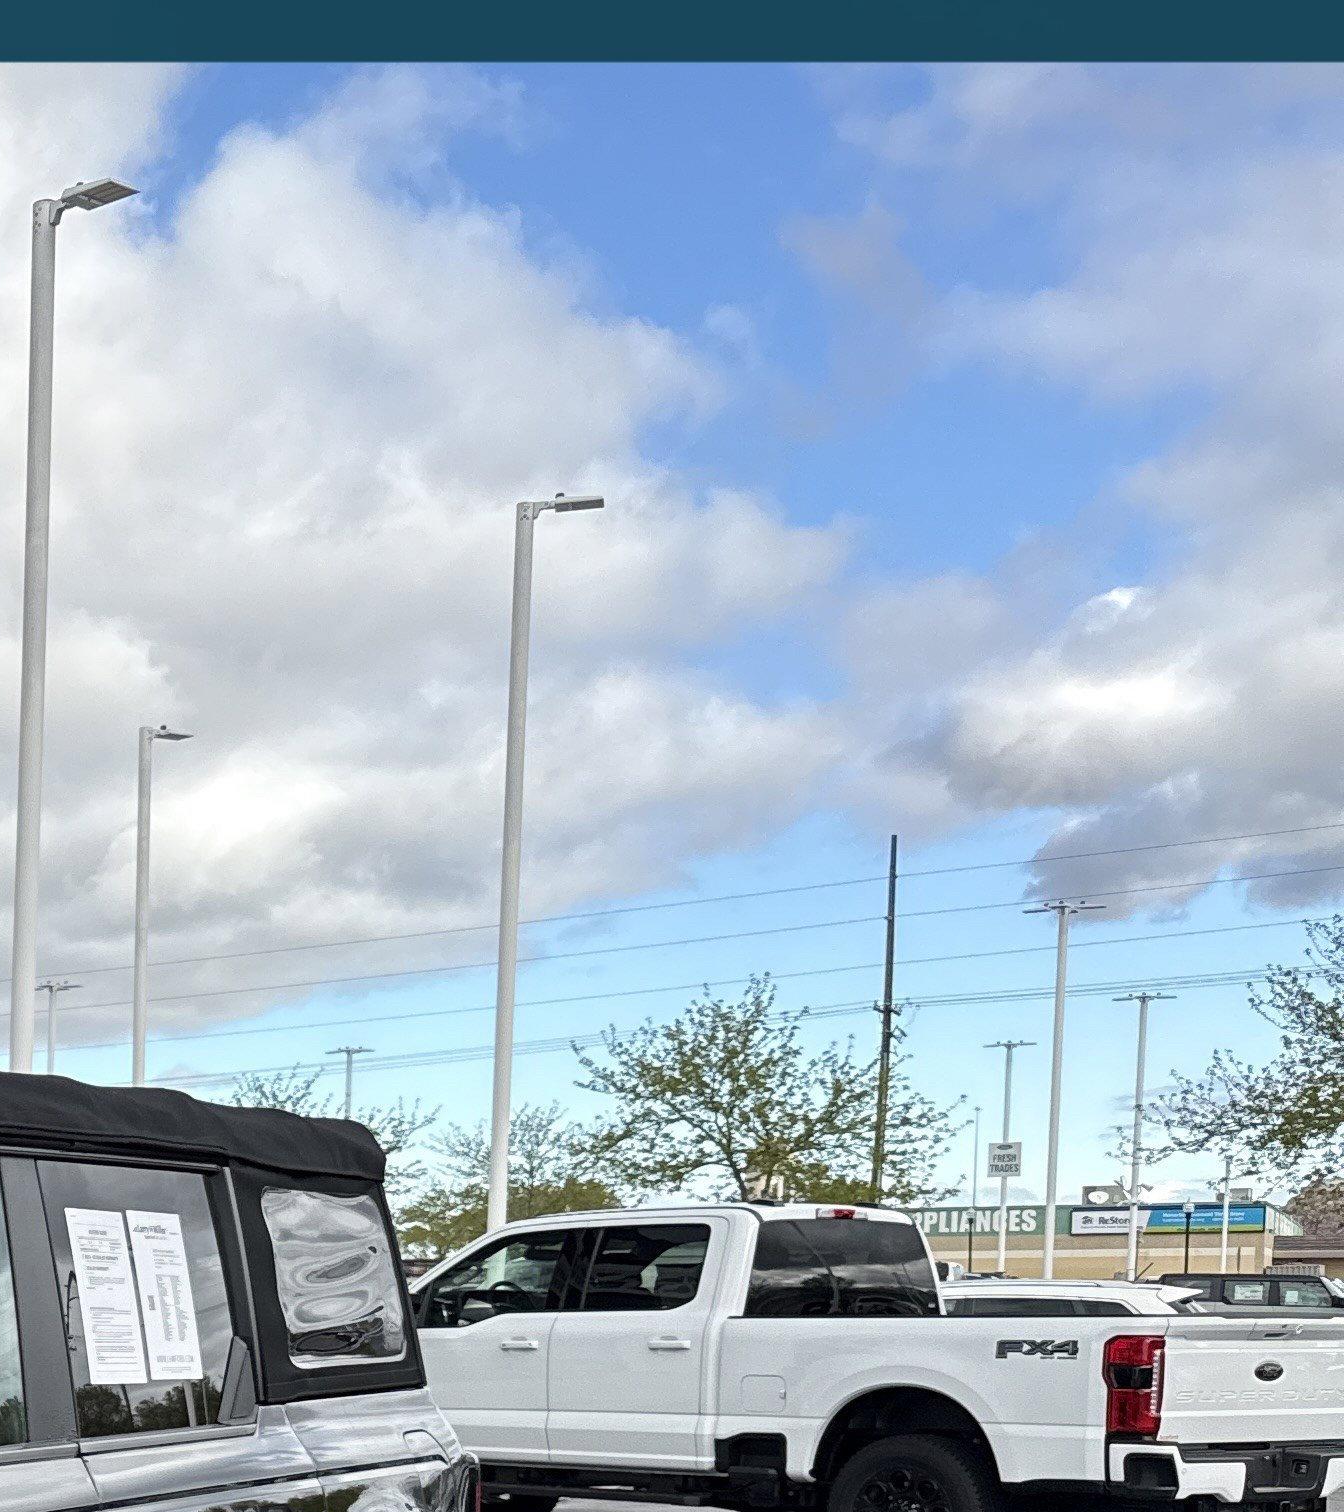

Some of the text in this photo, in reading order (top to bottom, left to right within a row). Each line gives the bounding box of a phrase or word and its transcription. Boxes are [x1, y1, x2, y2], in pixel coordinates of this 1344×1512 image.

[992, 1153, 1017, 1163] FRESH
[989, 1163, 1020, 1173] TRADES
[912, 1209, 1037, 1234] PPLIANCES
[1098, 1215, 1131, 1225] ReStor
[995, 1339, 1079, 1359] FX4
